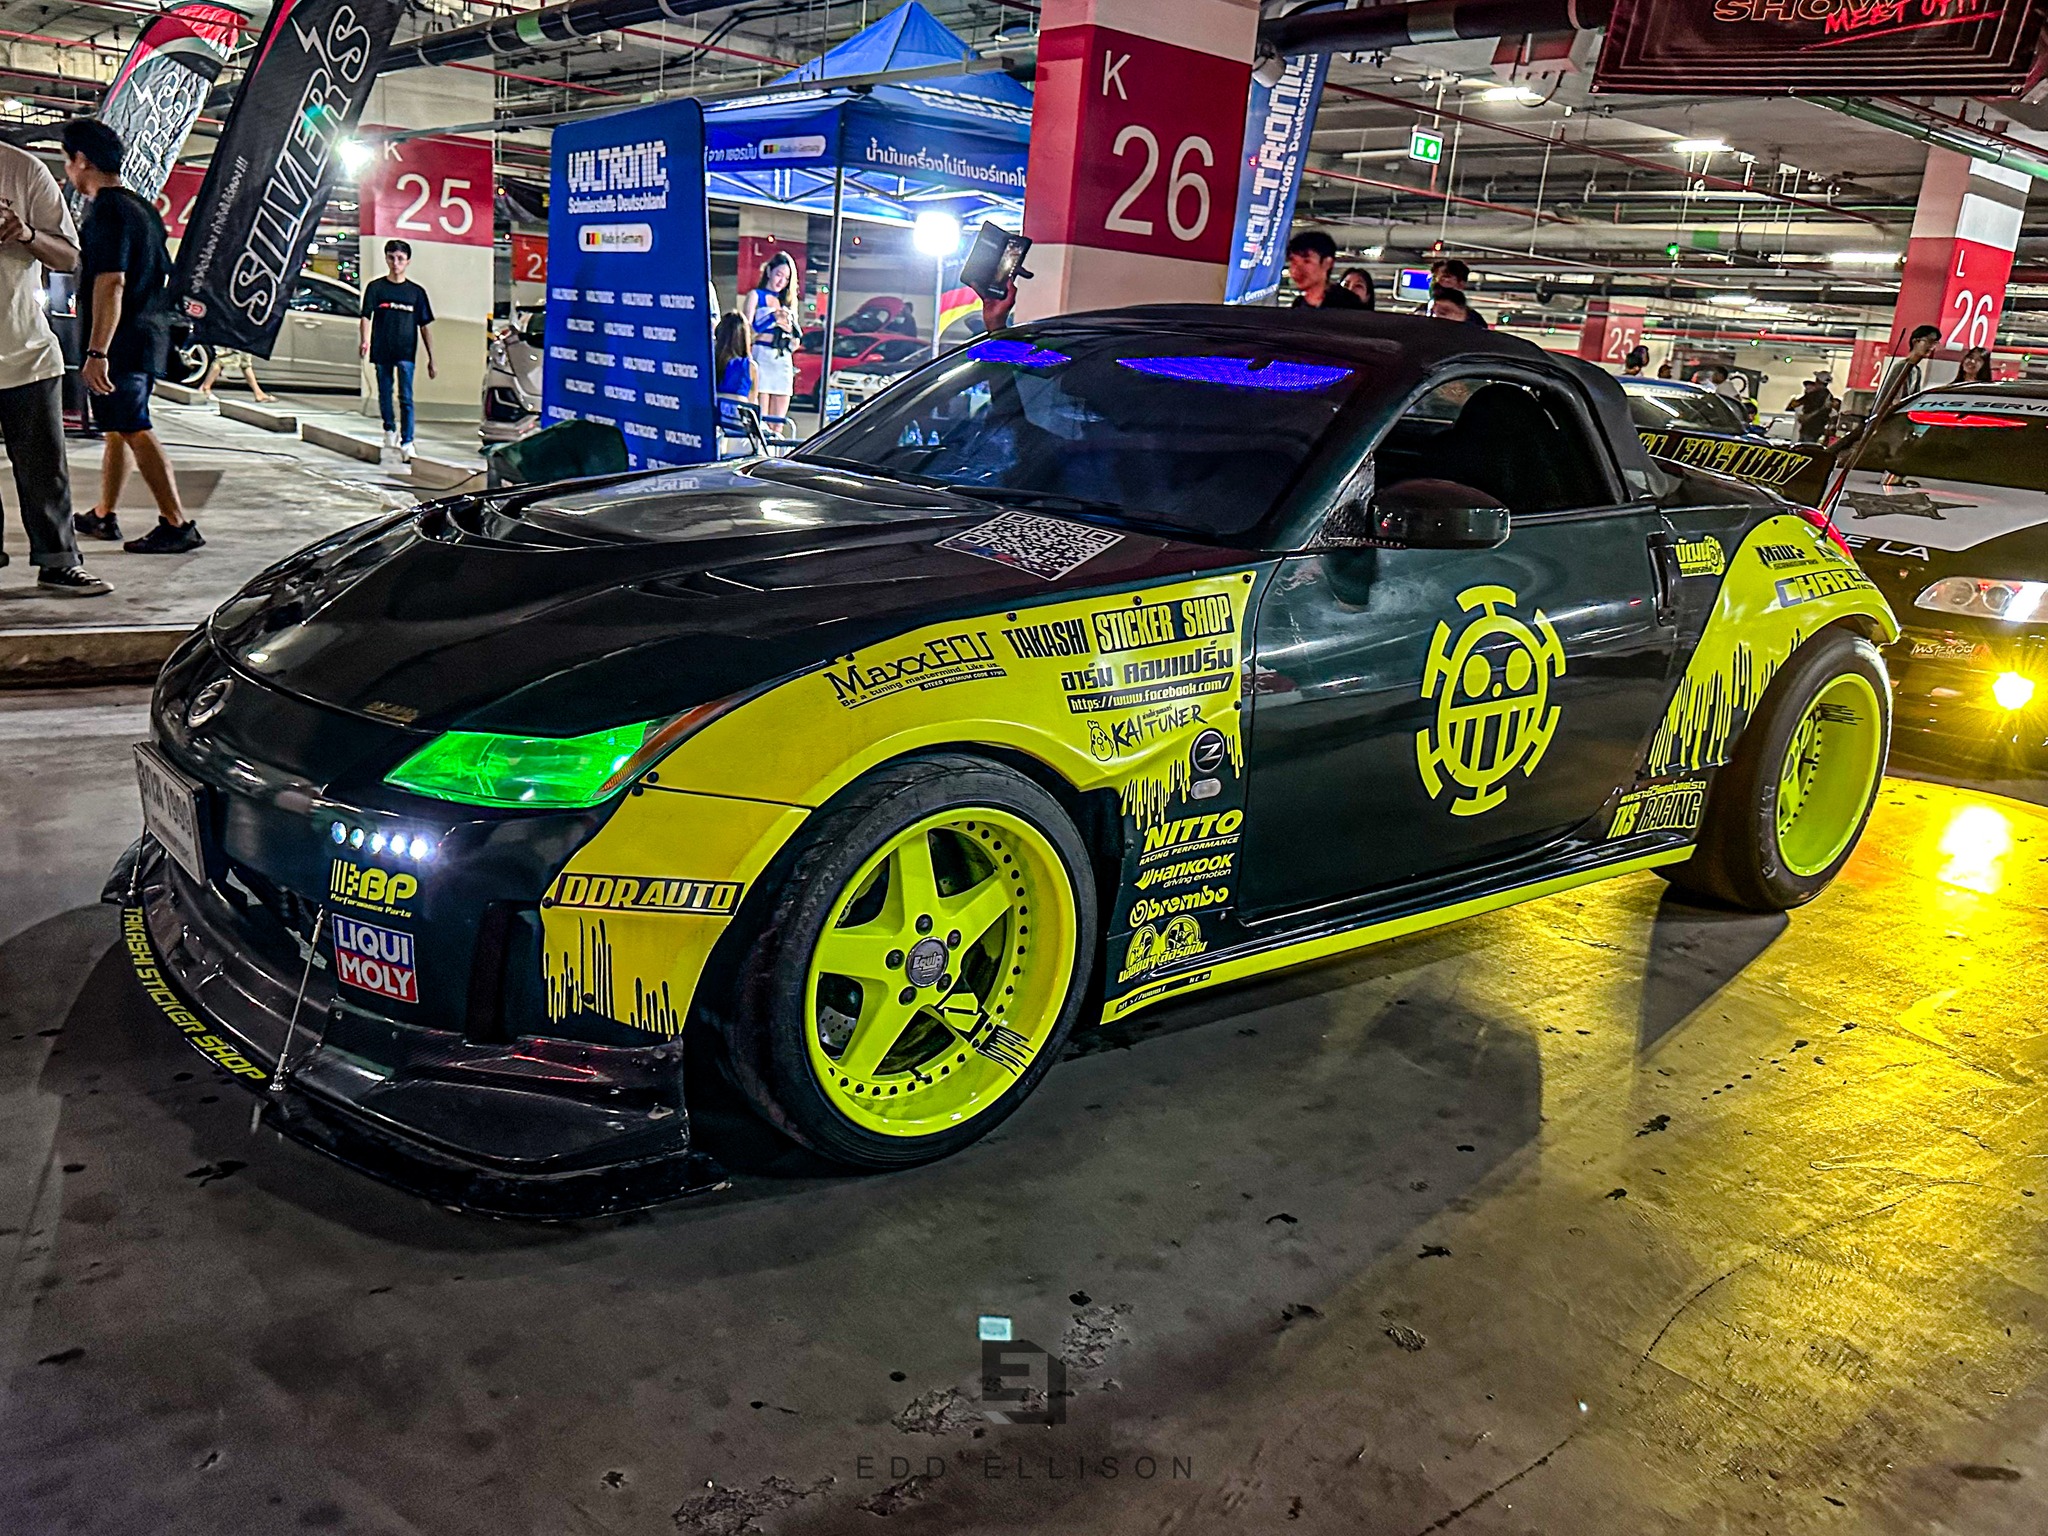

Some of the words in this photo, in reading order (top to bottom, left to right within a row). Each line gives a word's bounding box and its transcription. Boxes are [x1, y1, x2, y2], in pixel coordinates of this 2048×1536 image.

[1825, 0, 1906, 34] MEET
[1102, 49, 1131, 100] K
[384, 141, 402, 162] K
[568, 140, 667, 193] VOLTRONIC
[396, 174, 473, 236] 25
[1105, 125, 1215, 242] 26
[1956, 250, 1966, 279] L
[1606, 326, 1636, 360] 25
[1946, 290, 1993, 352] 26
[1918, 400, 1967, 408] TKS
[1672, 437, 1813, 485] FACTORY
[1877, 540, 1931, 562] LA
[1001, 618, 1091, 659] TAKASHI
[1094, 605, 1175, 652] STICKER
[1181, 595, 1231, 638] SHOP
[823, 631, 995, 701] MaxxECU
[870, 681, 903, 697] tuning
[905, 666, 965, 685] mastermind.
[966, 663, 985, 671] Like
[1070, 676, 1229, 712] https://www.facebook.com/
[1144, 704, 1208, 739] TUNER
[1143, 809, 1244, 854] NITTO
[1606, 801, 1641, 839] TKS
[1636, 790, 1703, 834] RACING
[1139, 850, 1169, 866] RACING
[1171, 837, 1239, 856] PERFORMANCE
[1163, 876, 1192, 888] driving
[1194, 869, 1231, 881] emotion
[331, 893, 384, 912] Performance
[385, 906, 412, 918] Parts
[1147, 885, 1229, 921] brembo
[124, 906, 155, 965] TAKASHI
[337, 919, 410, 965] LIQUI
[340, 952, 412, 997] MOLY
[136, 967, 207, 1033] STICKER
[192, 1035, 267, 1079] SHOP
